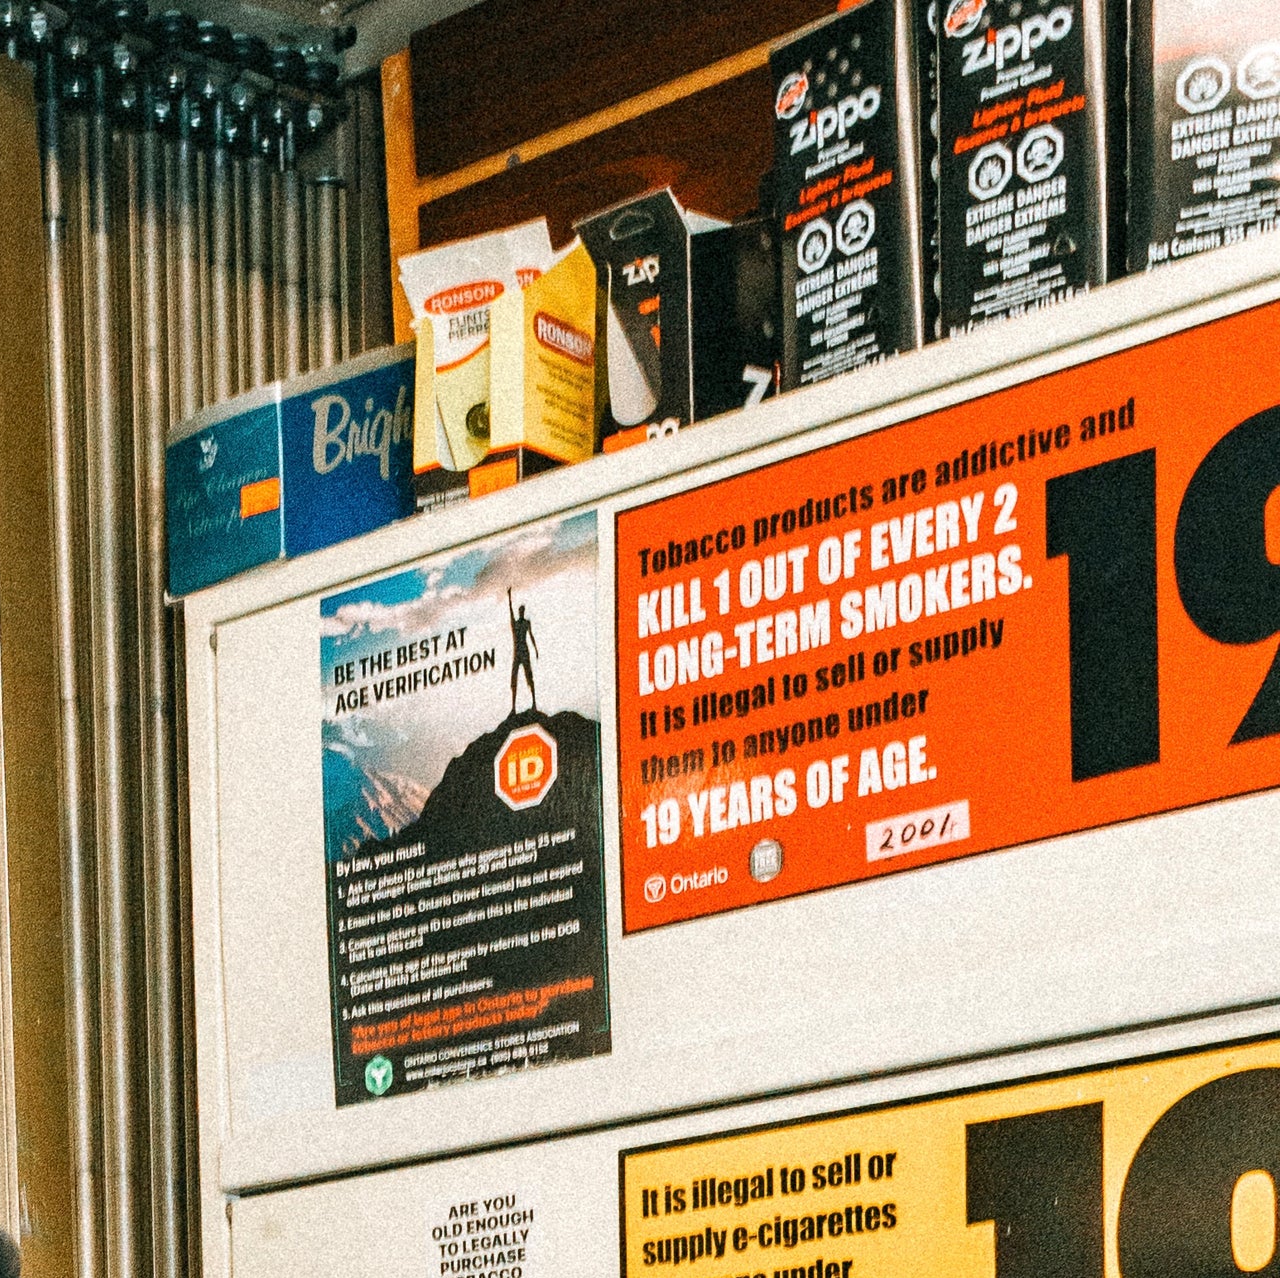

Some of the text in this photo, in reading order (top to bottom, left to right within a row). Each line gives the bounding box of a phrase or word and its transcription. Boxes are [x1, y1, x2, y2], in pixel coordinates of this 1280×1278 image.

[1172, 108, 1233, 141] EXTREME
[1172, 129, 1230, 161] DANGER
[966, 176, 1067, 226] EXTREME DANGER
[966, 212, 1013, 247] DANGER
[431, 284, 496, 312] RONSON
[537, 316, 594, 355] RONSON
[637, 397, 1137, 578] Tobacco products are addictive and
[637, 482, 1019, 639] KILL 1 OUT OF EVERY 2
[1044, 403, 1280, 784] 19
[637, 544, 1034, 698] LONG-TERM SMOKERS.
[334, 626, 468, 687] BE THE BEST AT
[640, 616, 1006, 740] It is illegal to sell or supply
[335, 646, 496, 715] AGE VERIFICATION
[640, 685, 931, 786] them to anyone under
[640, 733, 938, 849] 19 YEARS OF AGE.
[336, 859, 351, 877] By
[374, 850, 395, 870] you
[670, 864, 730, 897] Ontario
[494, 1034, 526, 1052] STORES
[527, 1020, 581, 1044] ASSOCIATION
[642, 1150, 898, 1219] It is illegal to sell or
[431, 1208, 535, 1242] OLD ENOUGH
[448, 1194, 516, 1220] ARE YOU
[438, 1228, 530, 1259] TO LEGALLY
[643, 1202, 898, 1268] supply e-cigarettes
[439, 1247, 527, 1276] PURCHASE
